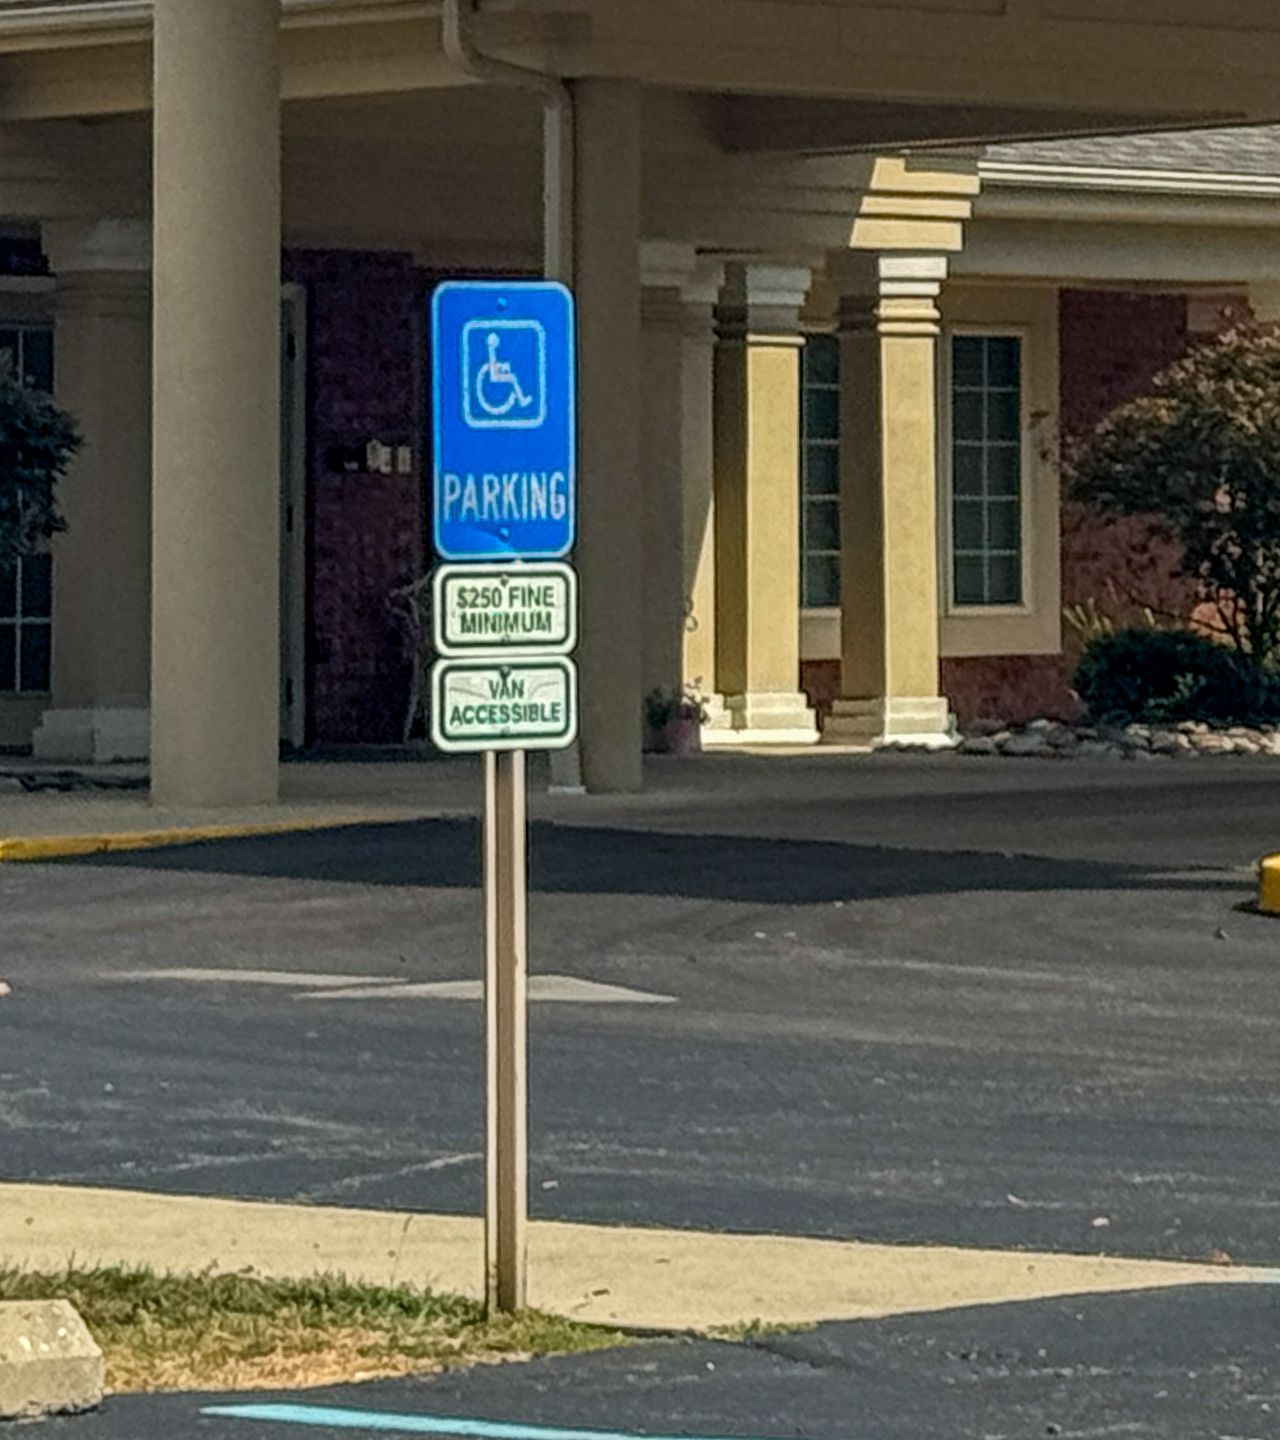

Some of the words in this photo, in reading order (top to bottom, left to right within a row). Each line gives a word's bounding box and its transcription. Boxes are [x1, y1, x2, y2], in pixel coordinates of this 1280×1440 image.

[444, 472, 565, 522] PARKING
[456, 585, 501, 609] $250
[508, 584, 555, 608] FINE
[460, 612, 552, 634] MINIMUM
[489, 679, 525, 699] VAN
[450, 702, 561, 726] ACCESSIBLE
